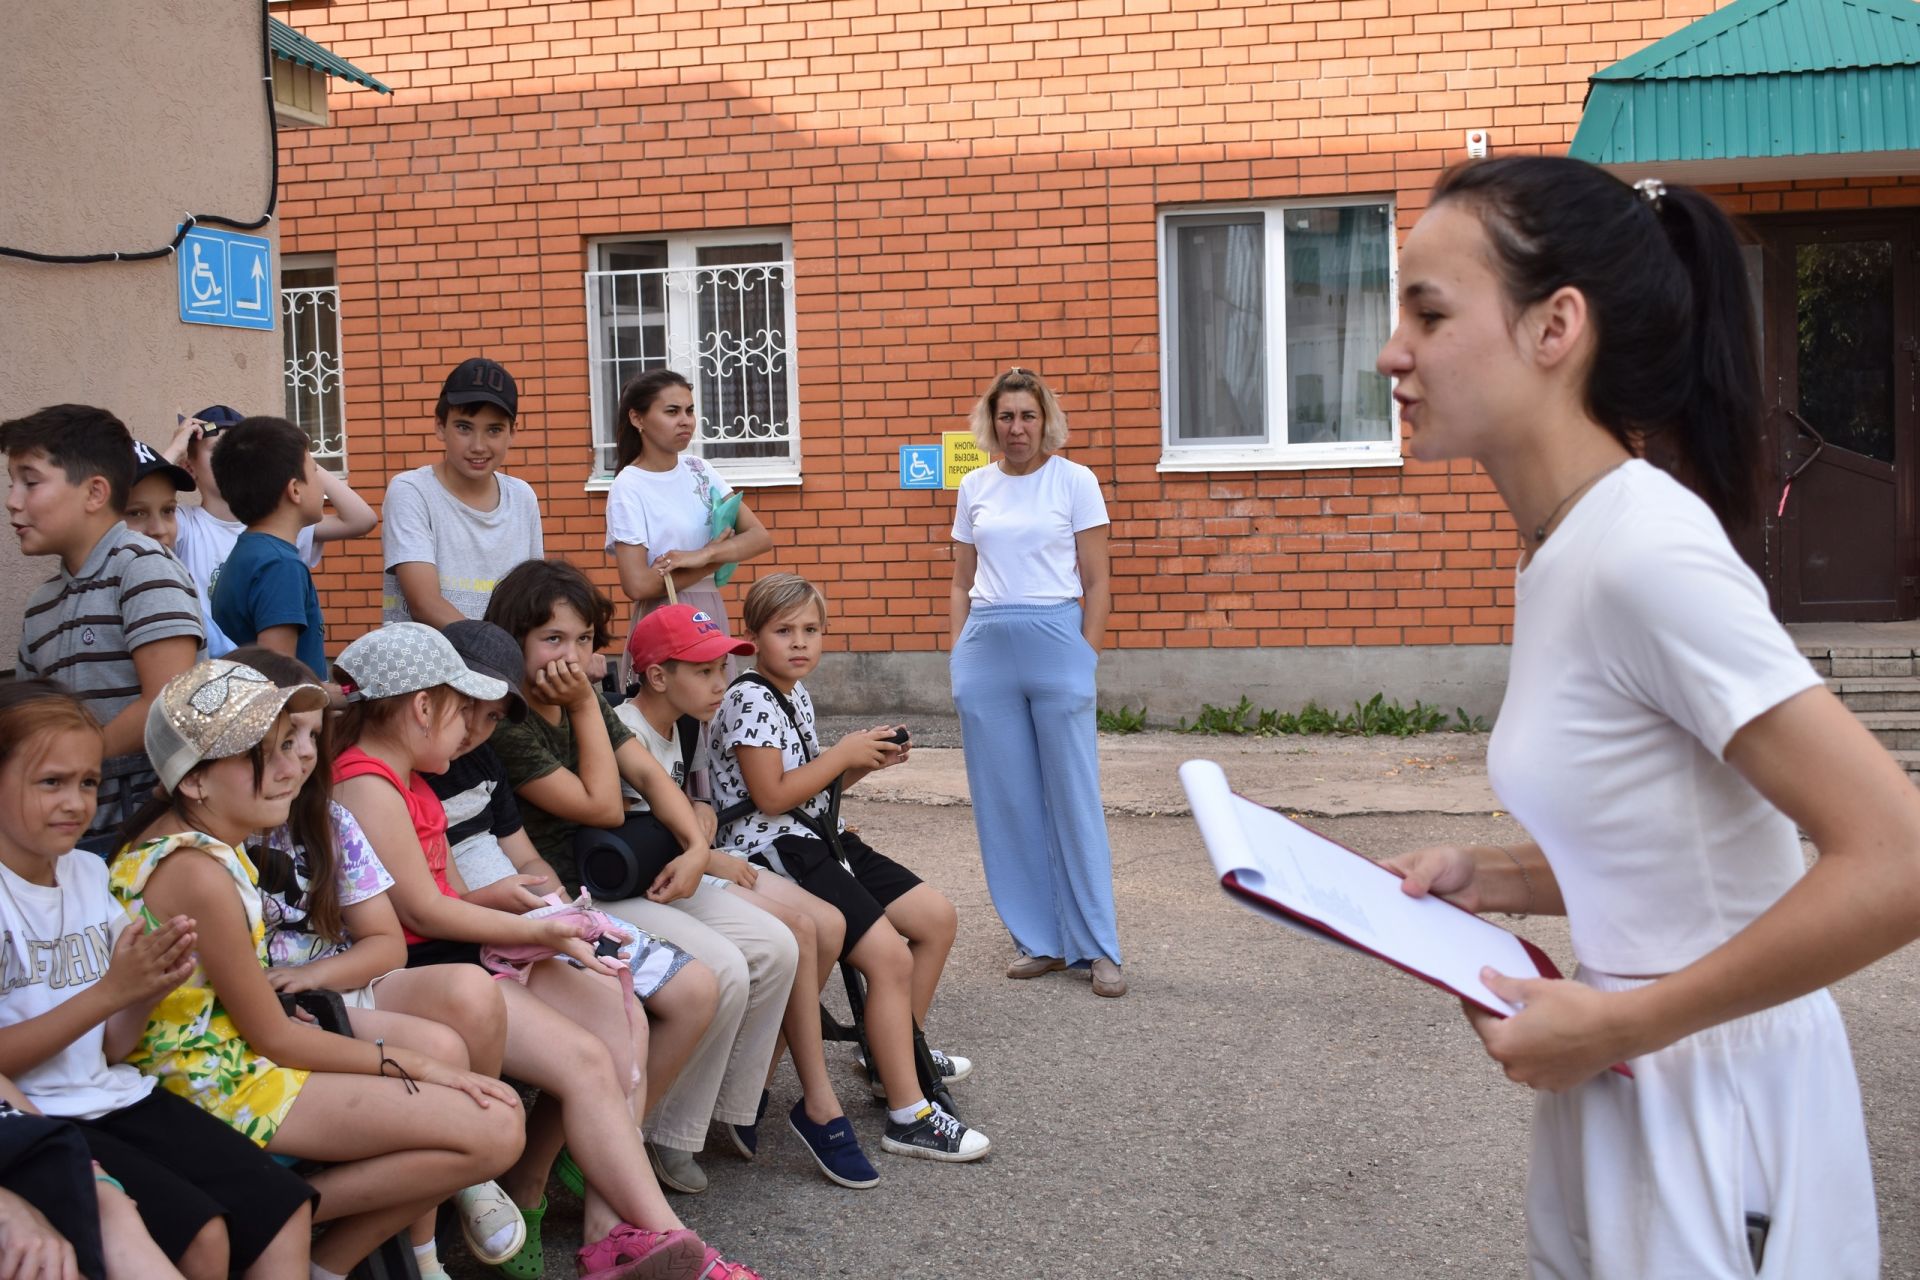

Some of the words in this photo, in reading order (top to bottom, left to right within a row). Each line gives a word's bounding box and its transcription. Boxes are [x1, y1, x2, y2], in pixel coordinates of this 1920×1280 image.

[471, 365, 504, 392] 10
[954, 453, 979, 462] ВЫЗОВА
[948, 465, 984, 475] ПЕРСОНА
